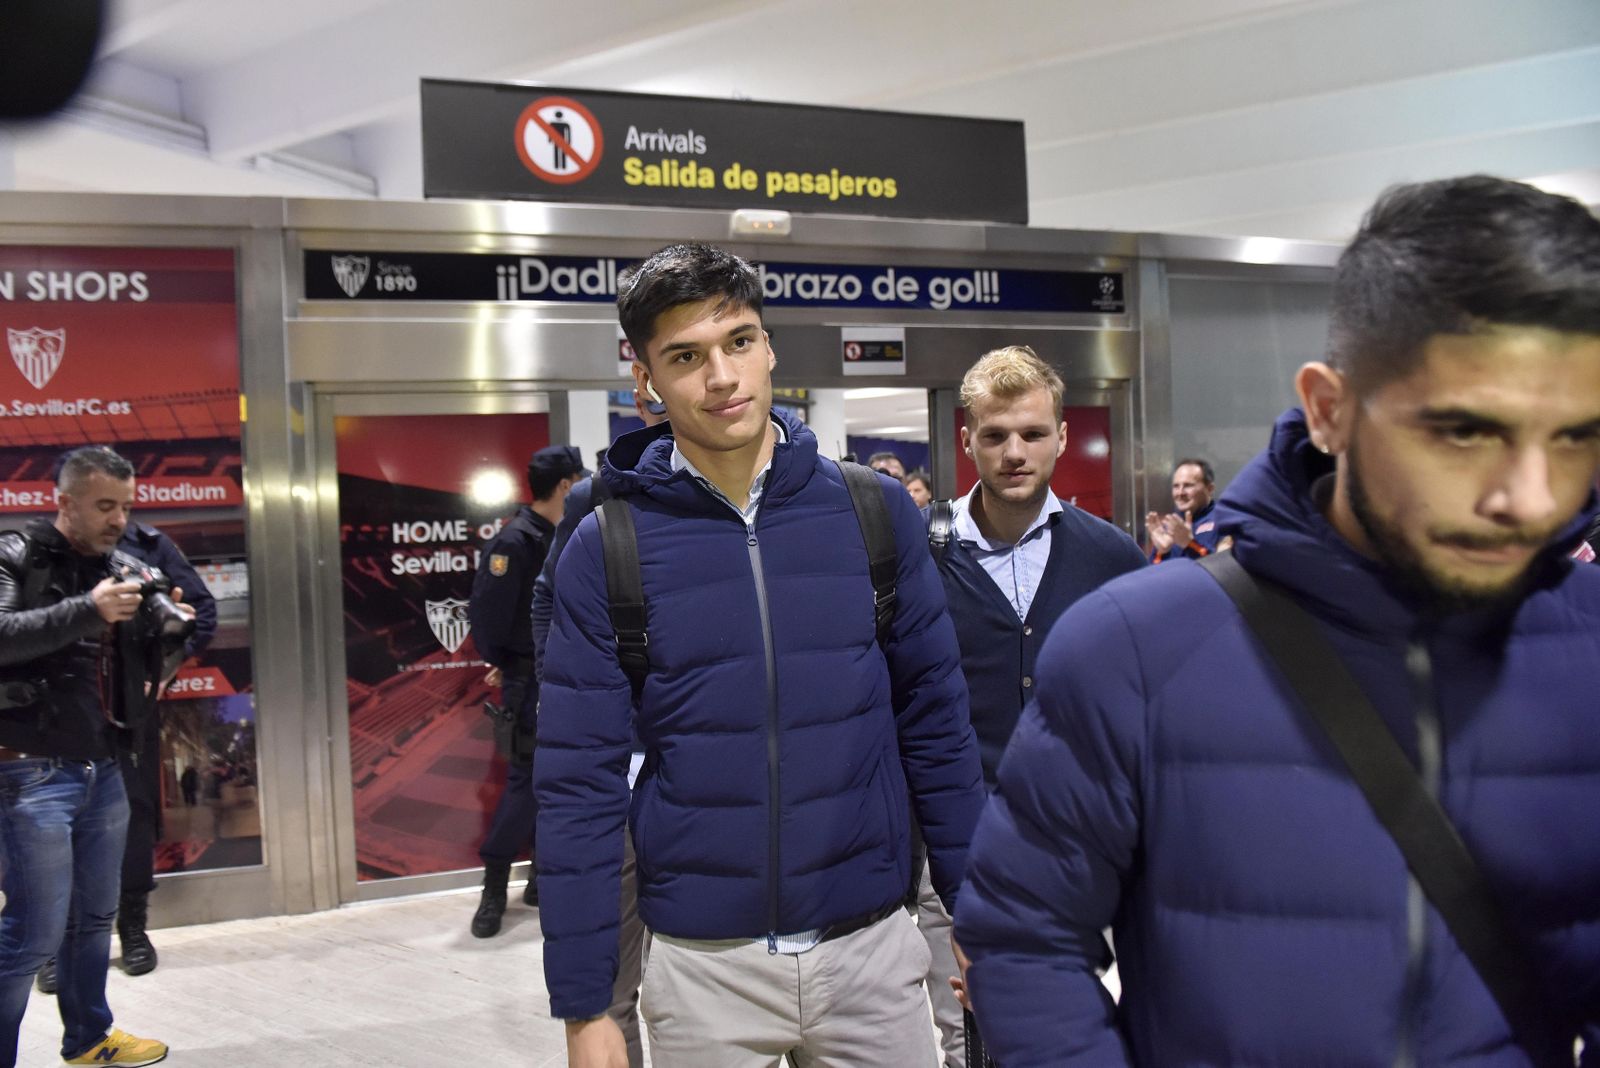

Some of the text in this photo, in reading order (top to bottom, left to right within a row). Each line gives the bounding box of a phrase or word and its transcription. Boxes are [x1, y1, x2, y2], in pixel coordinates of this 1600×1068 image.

[624, 125, 707, 154] Arrivals
[623, 156, 898, 201] Salida de pasajeros
[27, 270, 150, 301] SHOPS
[374, 274, 417, 292] 1890
[496, 258, 1000, 311] ¡¡Dadl brazo de gol!!
[136, 482, 227, 502] Stadium
[392, 520, 467, 543] HOME
[391, 552, 467, 575] Sevilla
[169, 676, 215, 692] erez
